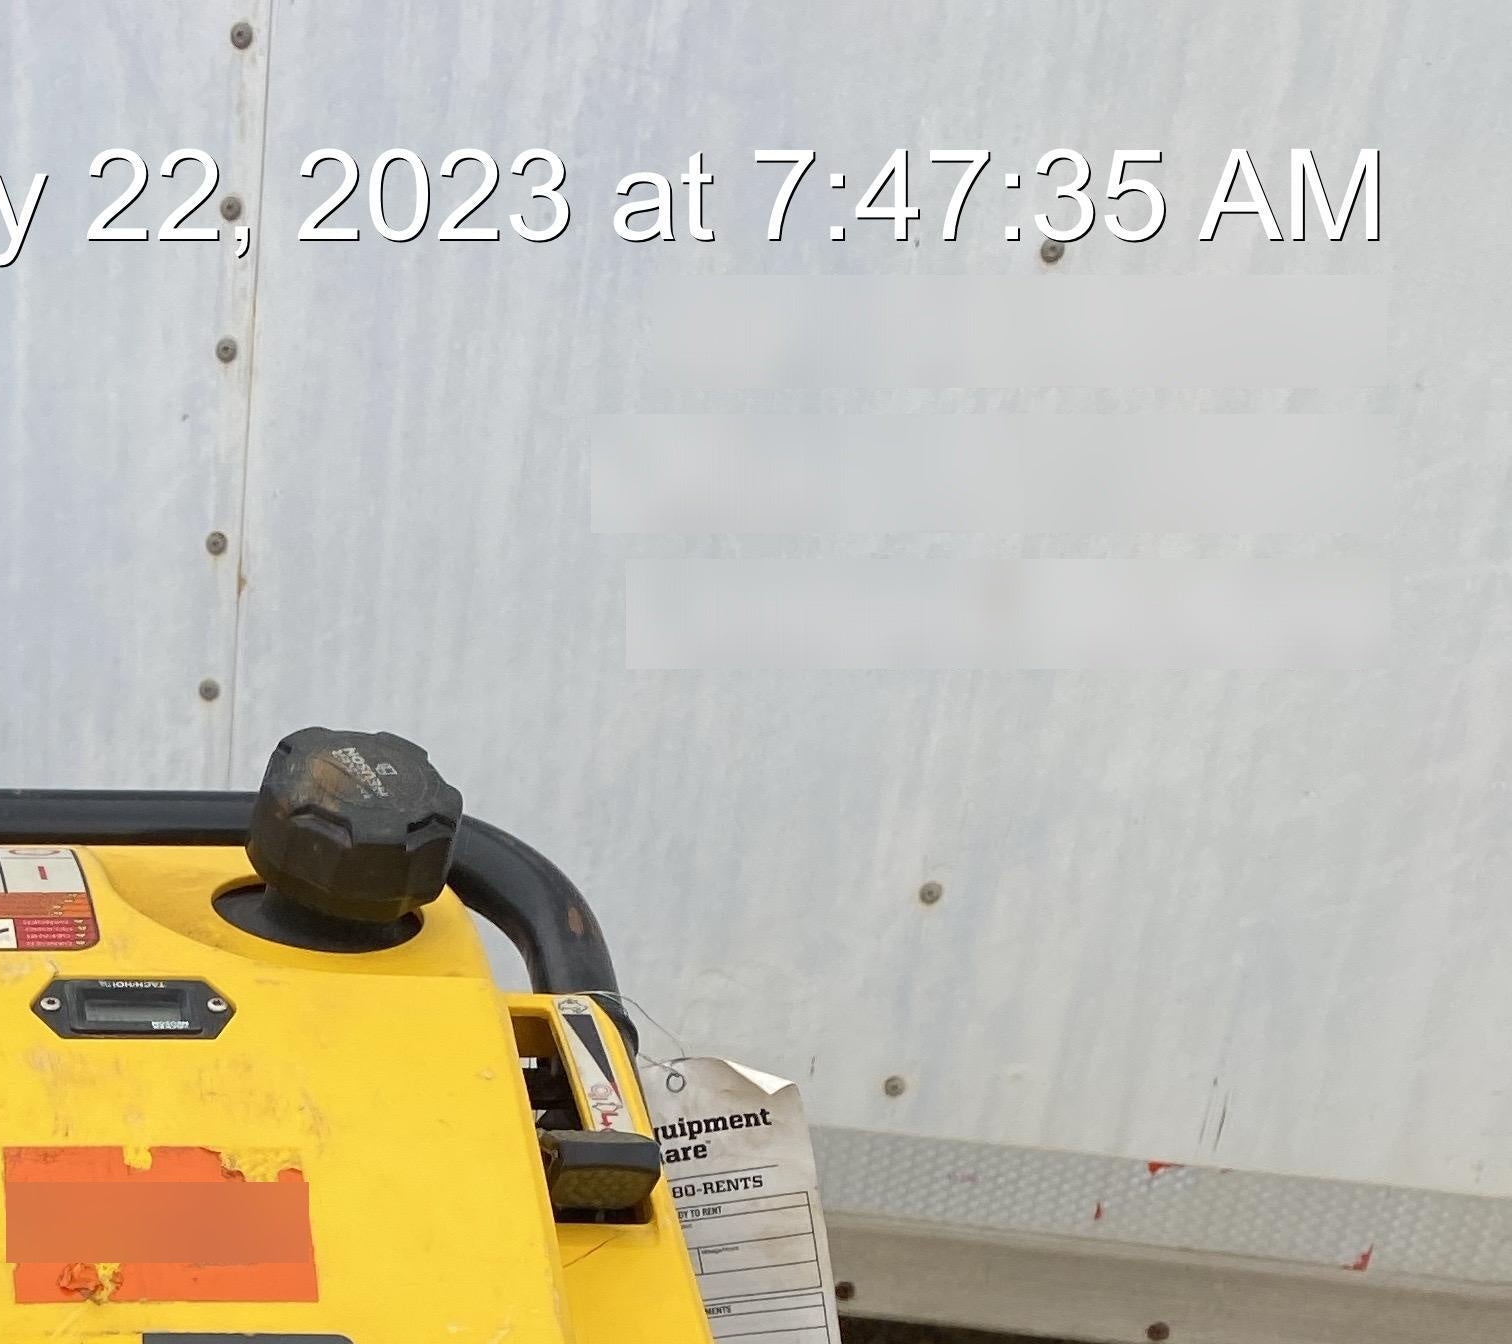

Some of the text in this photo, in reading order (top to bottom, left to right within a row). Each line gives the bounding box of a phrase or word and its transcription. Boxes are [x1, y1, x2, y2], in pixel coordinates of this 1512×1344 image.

[661, 1141, 709, 1166] are
[672, 1175, 763, 1199] 80-RENTS
[690, 1209, 700, 1218] TO
[702, 1206, 722, 1216] RENT
